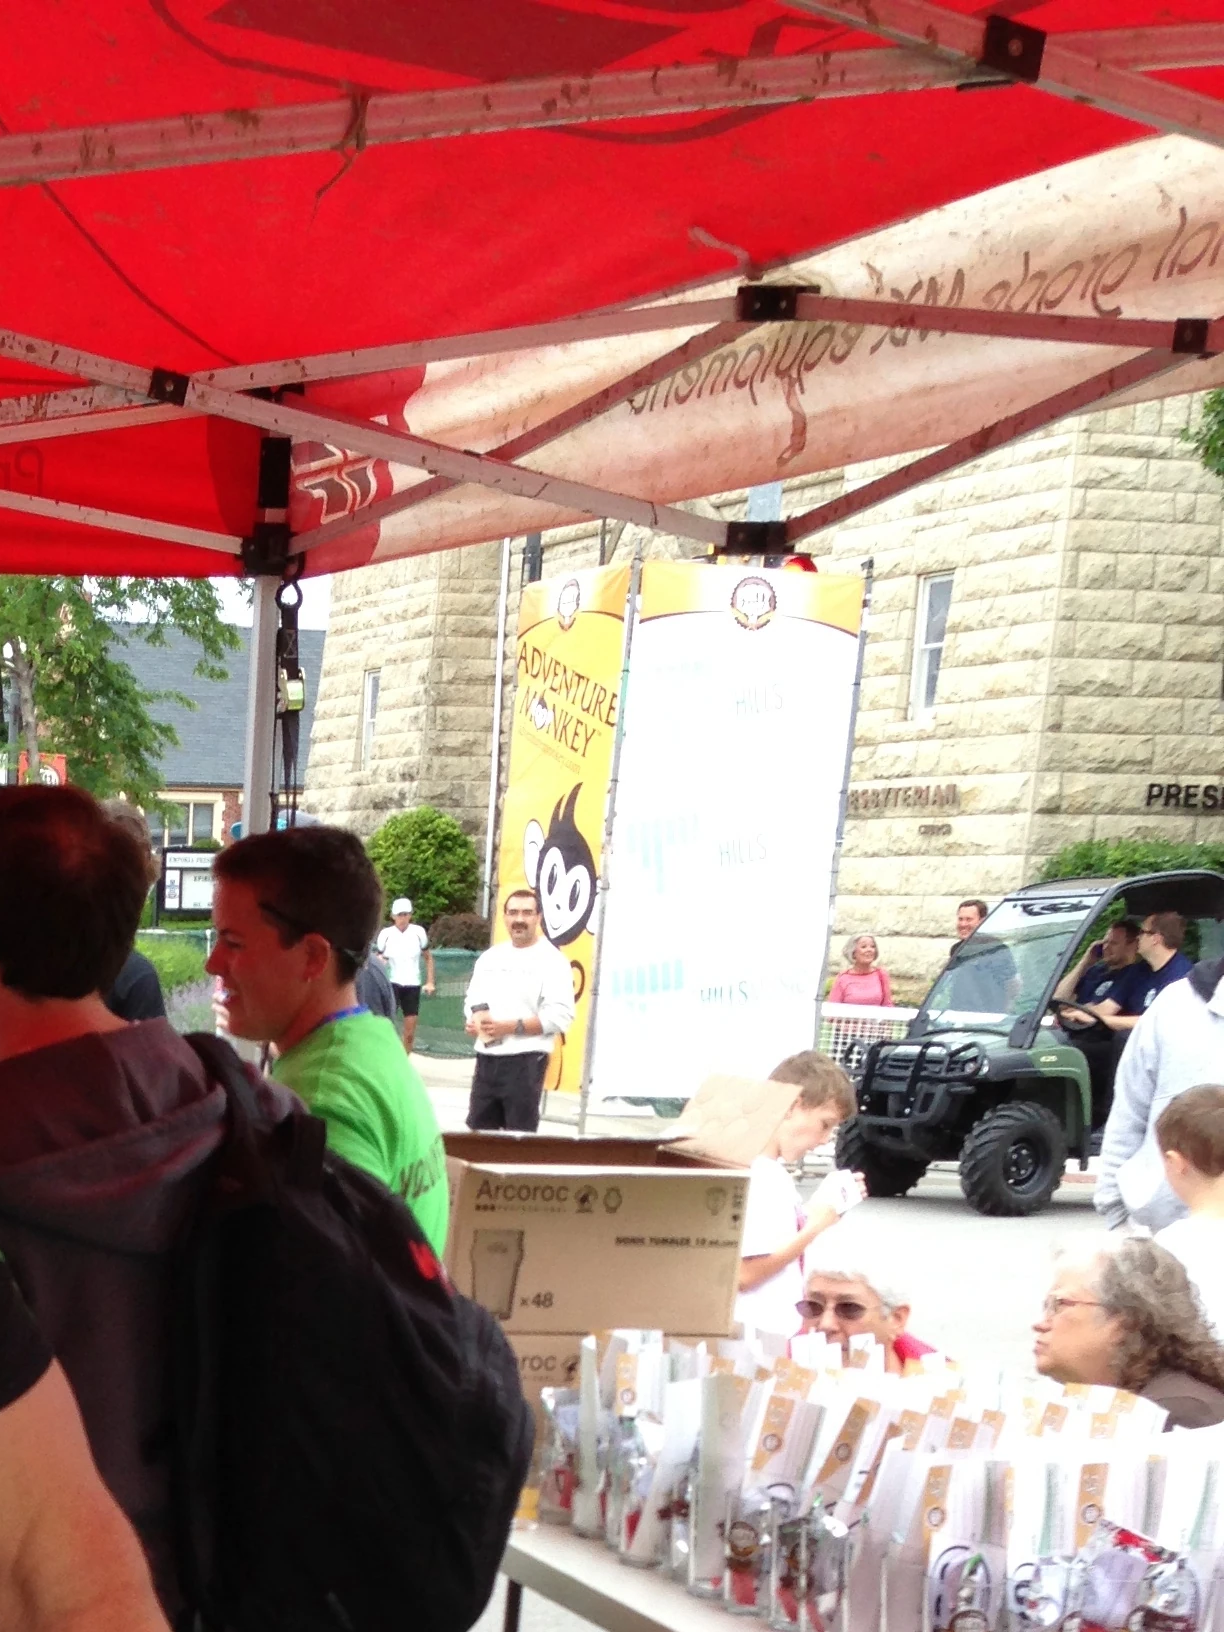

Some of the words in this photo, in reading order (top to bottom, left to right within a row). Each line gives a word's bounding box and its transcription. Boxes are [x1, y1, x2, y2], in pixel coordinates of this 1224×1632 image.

[517, 641, 618, 727] ADVENTURE
[1146, 783, 1224, 810] PRES
[476, 1179, 570, 1202] Arcoroc
